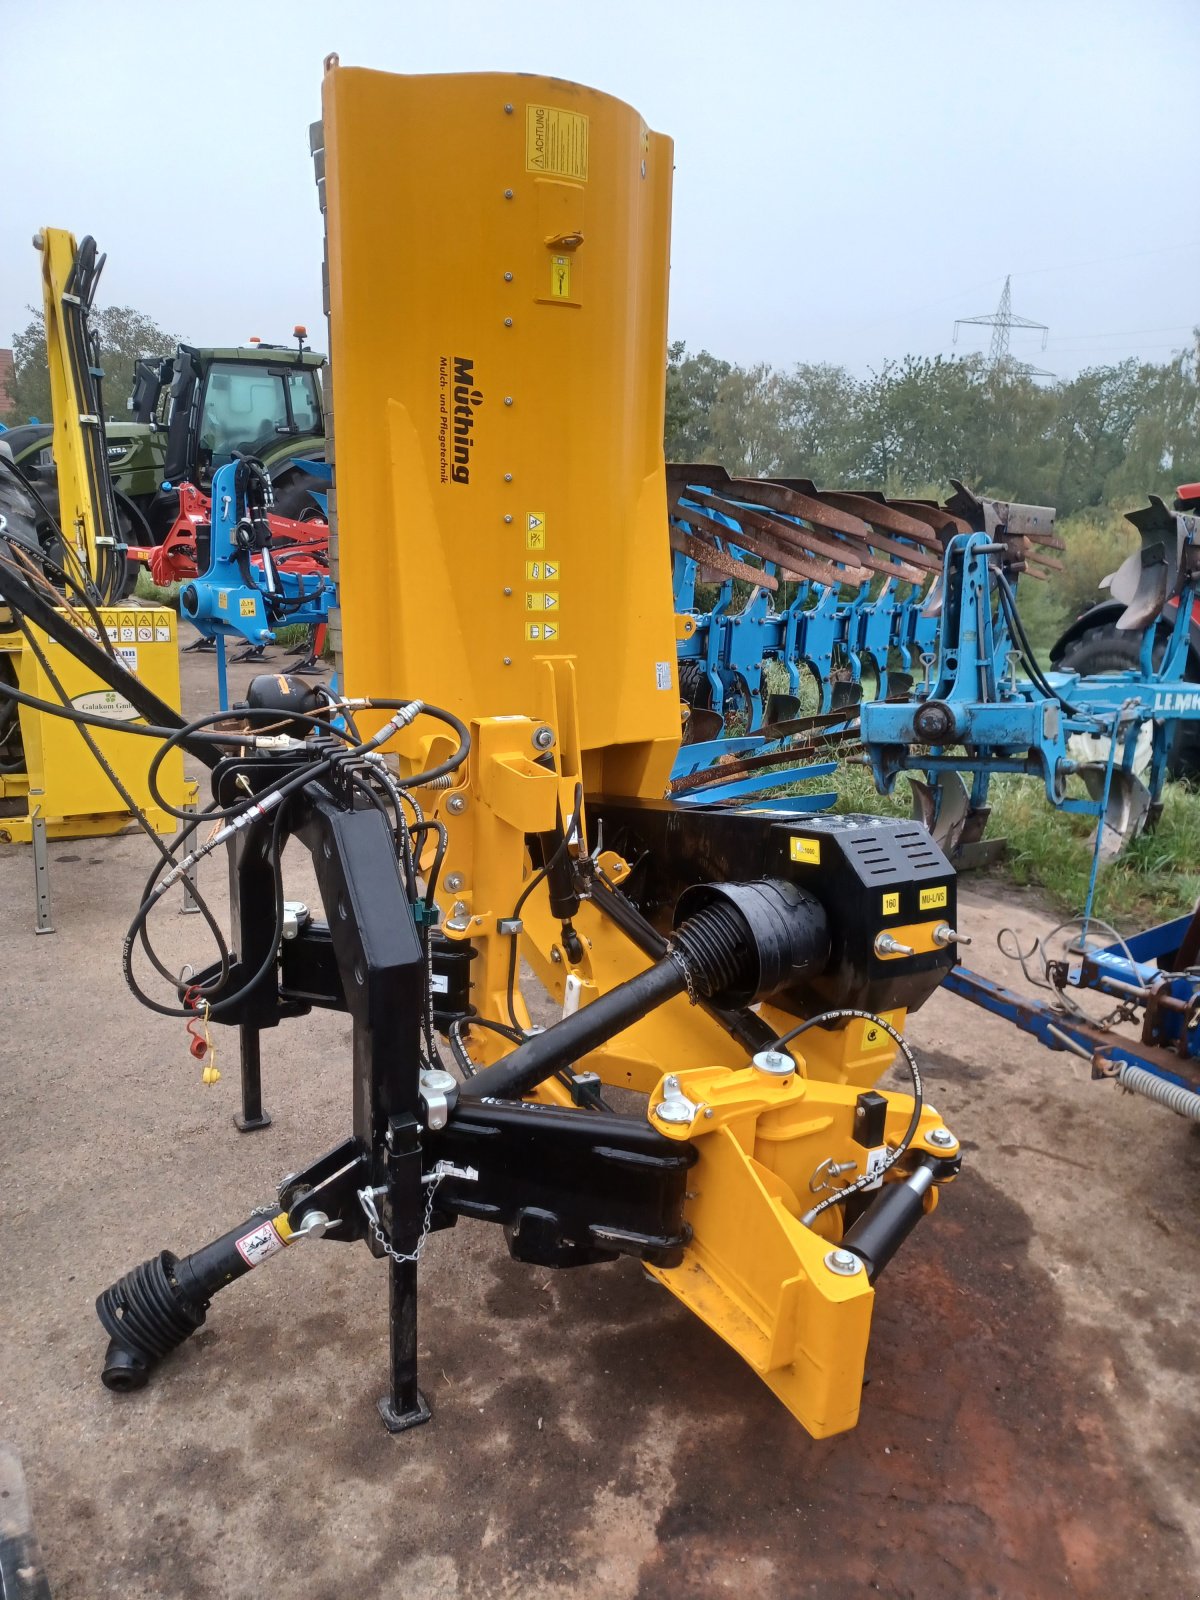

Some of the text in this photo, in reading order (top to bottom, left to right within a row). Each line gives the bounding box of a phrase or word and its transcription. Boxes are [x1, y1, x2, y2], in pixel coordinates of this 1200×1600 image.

[536, 109, 545, 153] ACHTUNG
[452, 356, 484, 485] Müthing
[439, 416, 448, 484] Pflegetechnik
[886, 899, 896, 909] 160
[922, 892, 945, 905] MU-L/VS
